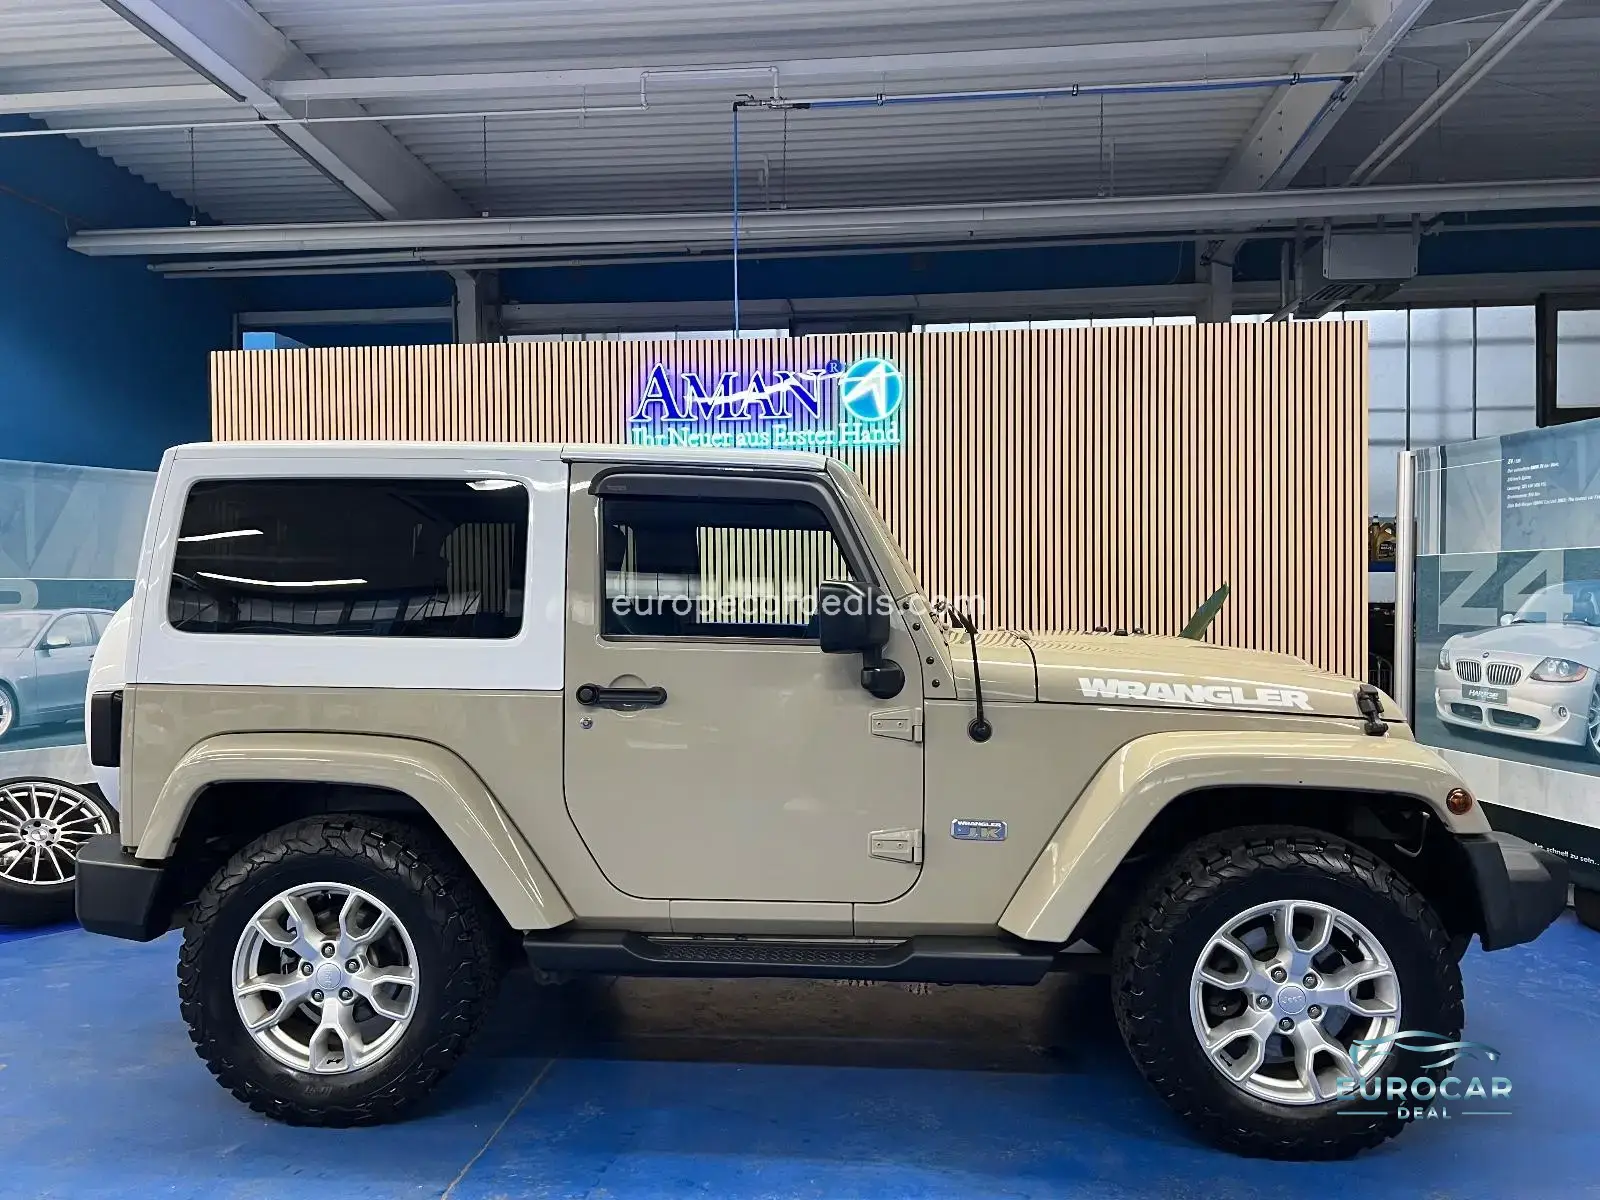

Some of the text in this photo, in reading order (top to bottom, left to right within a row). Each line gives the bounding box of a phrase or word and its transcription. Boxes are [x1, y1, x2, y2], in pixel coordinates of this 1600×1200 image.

[629, 362, 826, 421] AMAN
[632, 421, 900, 447] Ihr Neuer aus Erster Hand
[1438, 550, 1574, 626] Z4
[1078, 677, 1314, 711] WRANGLER
